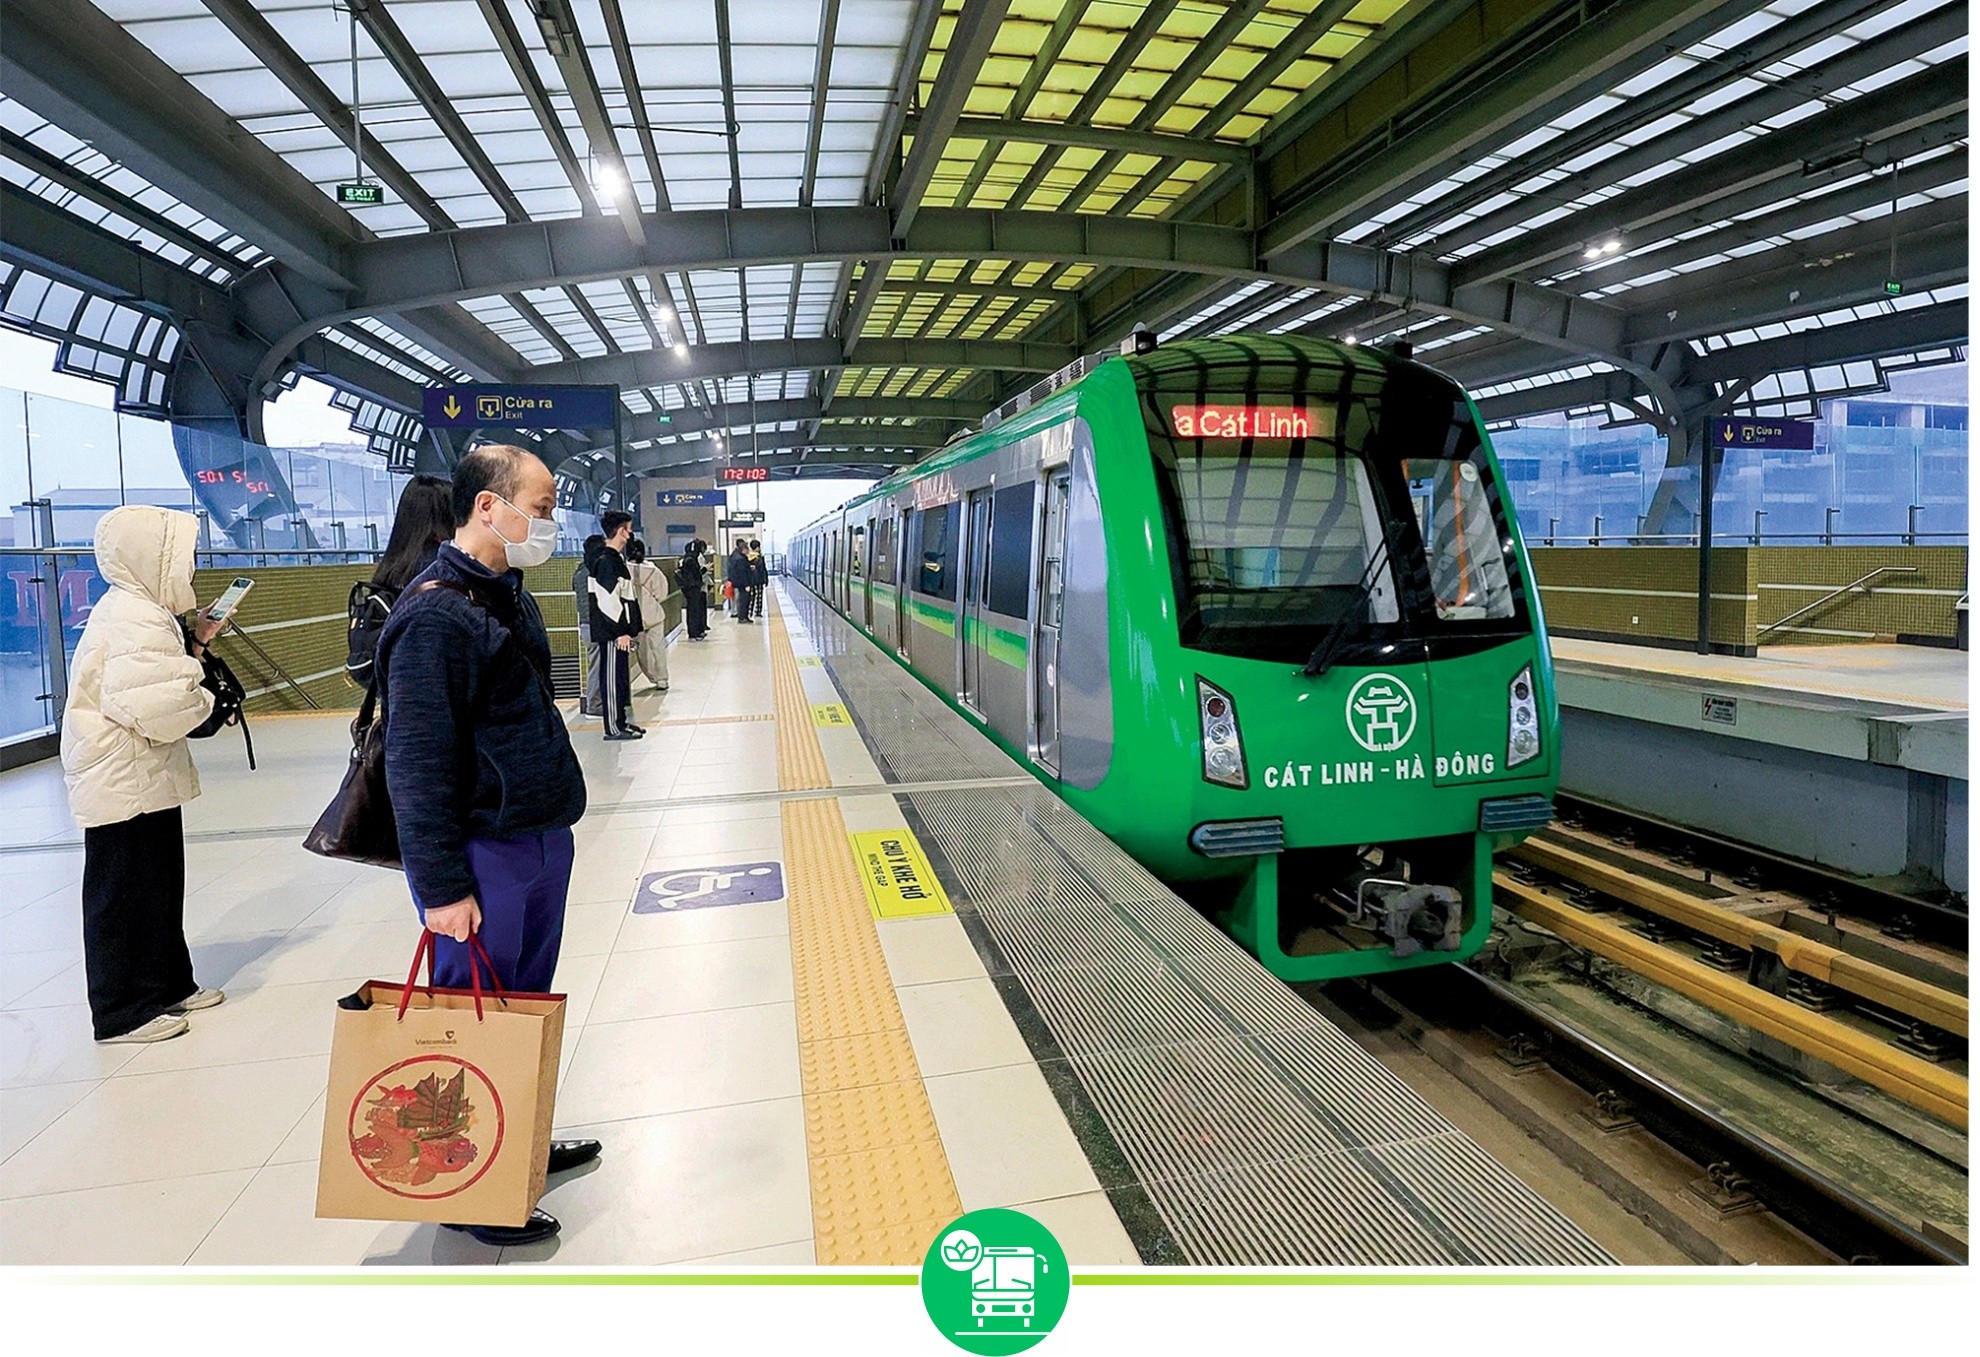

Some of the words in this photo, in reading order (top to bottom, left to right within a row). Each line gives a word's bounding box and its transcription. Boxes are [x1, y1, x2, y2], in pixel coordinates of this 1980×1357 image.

[345, 188, 375, 197] EXIT
[505, 396, 535, 409] Cửa
[539, 399, 553, 409] ra
[505, 411, 523, 419] Exit
[1200, 410, 1249, 437] Cát
[1254, 412, 1308, 438] Linh
[1264, 761, 1312, 788] CÁT
[1321, 761, 1374, 785] LINH
[1396, 754, 1425, 780] HÀ
[1436, 751, 1494, 777] ĐÔNG
[880, 839, 909, 857] CHÚ
[890, 864, 918, 884] KHE
